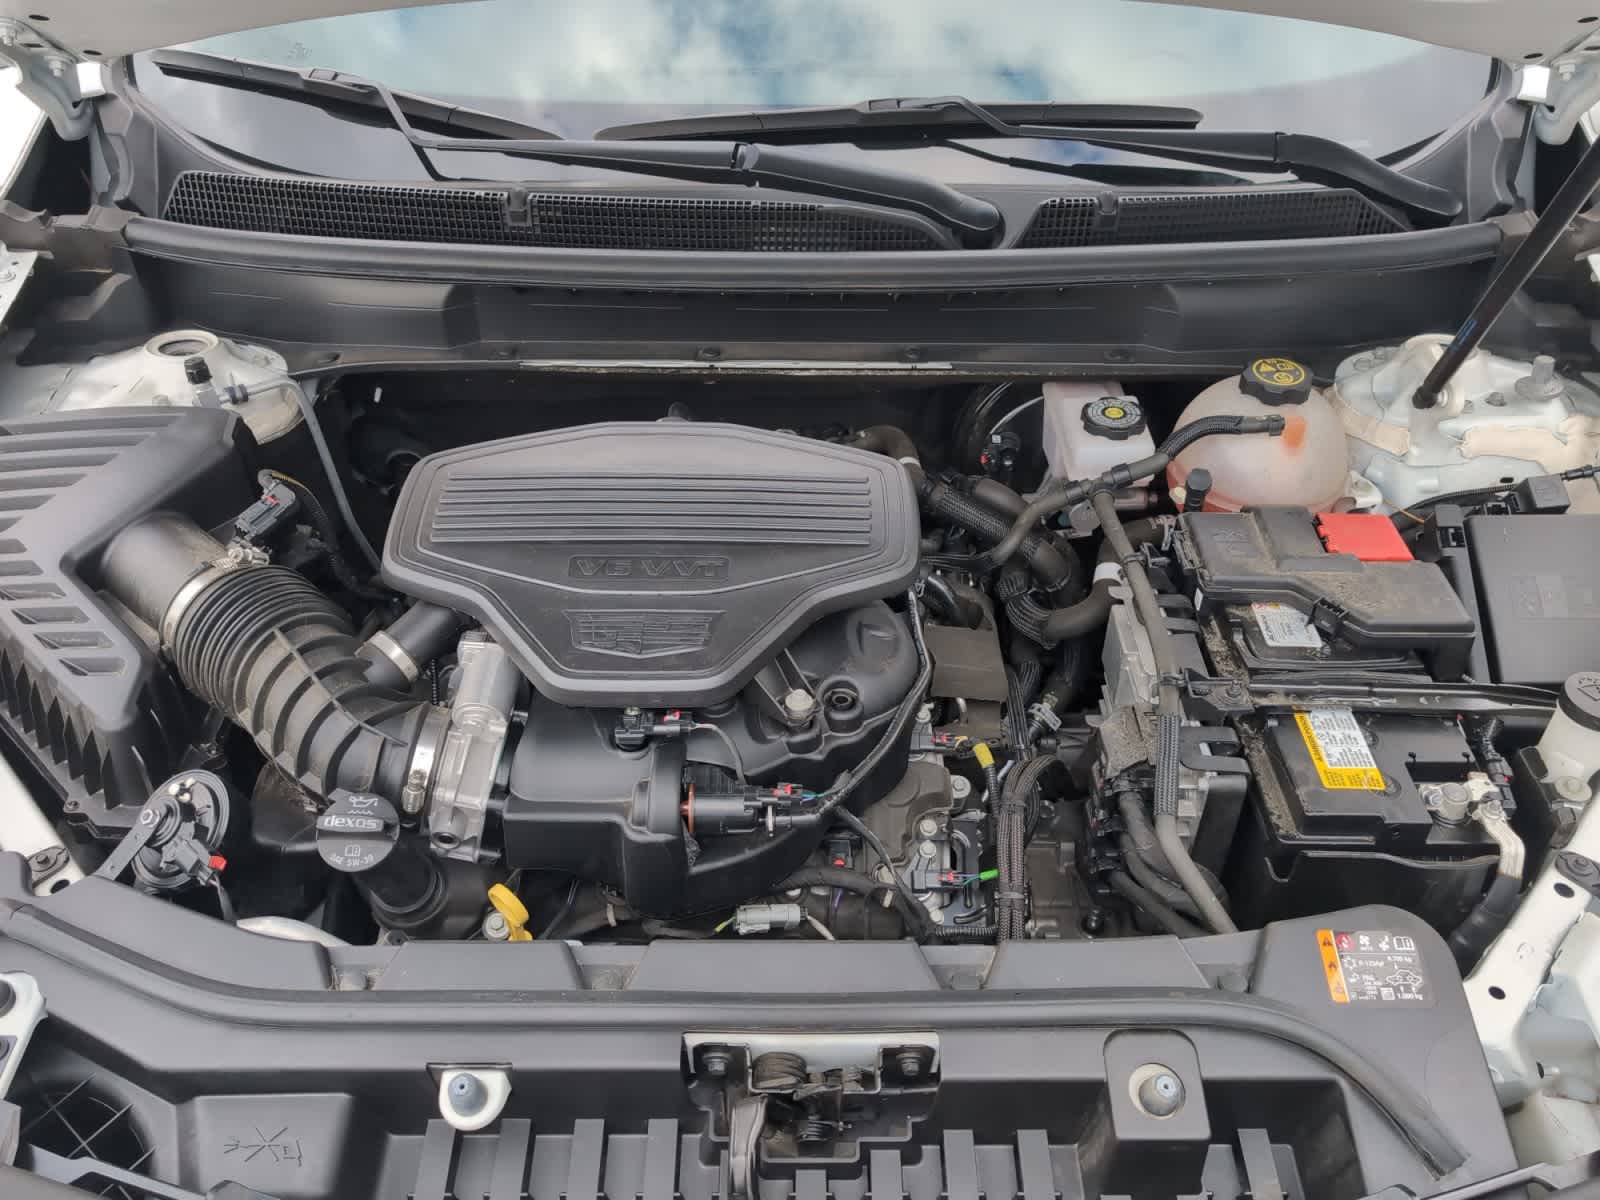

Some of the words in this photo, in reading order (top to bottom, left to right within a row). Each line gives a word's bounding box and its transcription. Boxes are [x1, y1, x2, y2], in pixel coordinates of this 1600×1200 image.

[576, 560, 633, 576] V6
[640, 559, 726, 577] VVT
[323, 815, 378, 829] dexos
